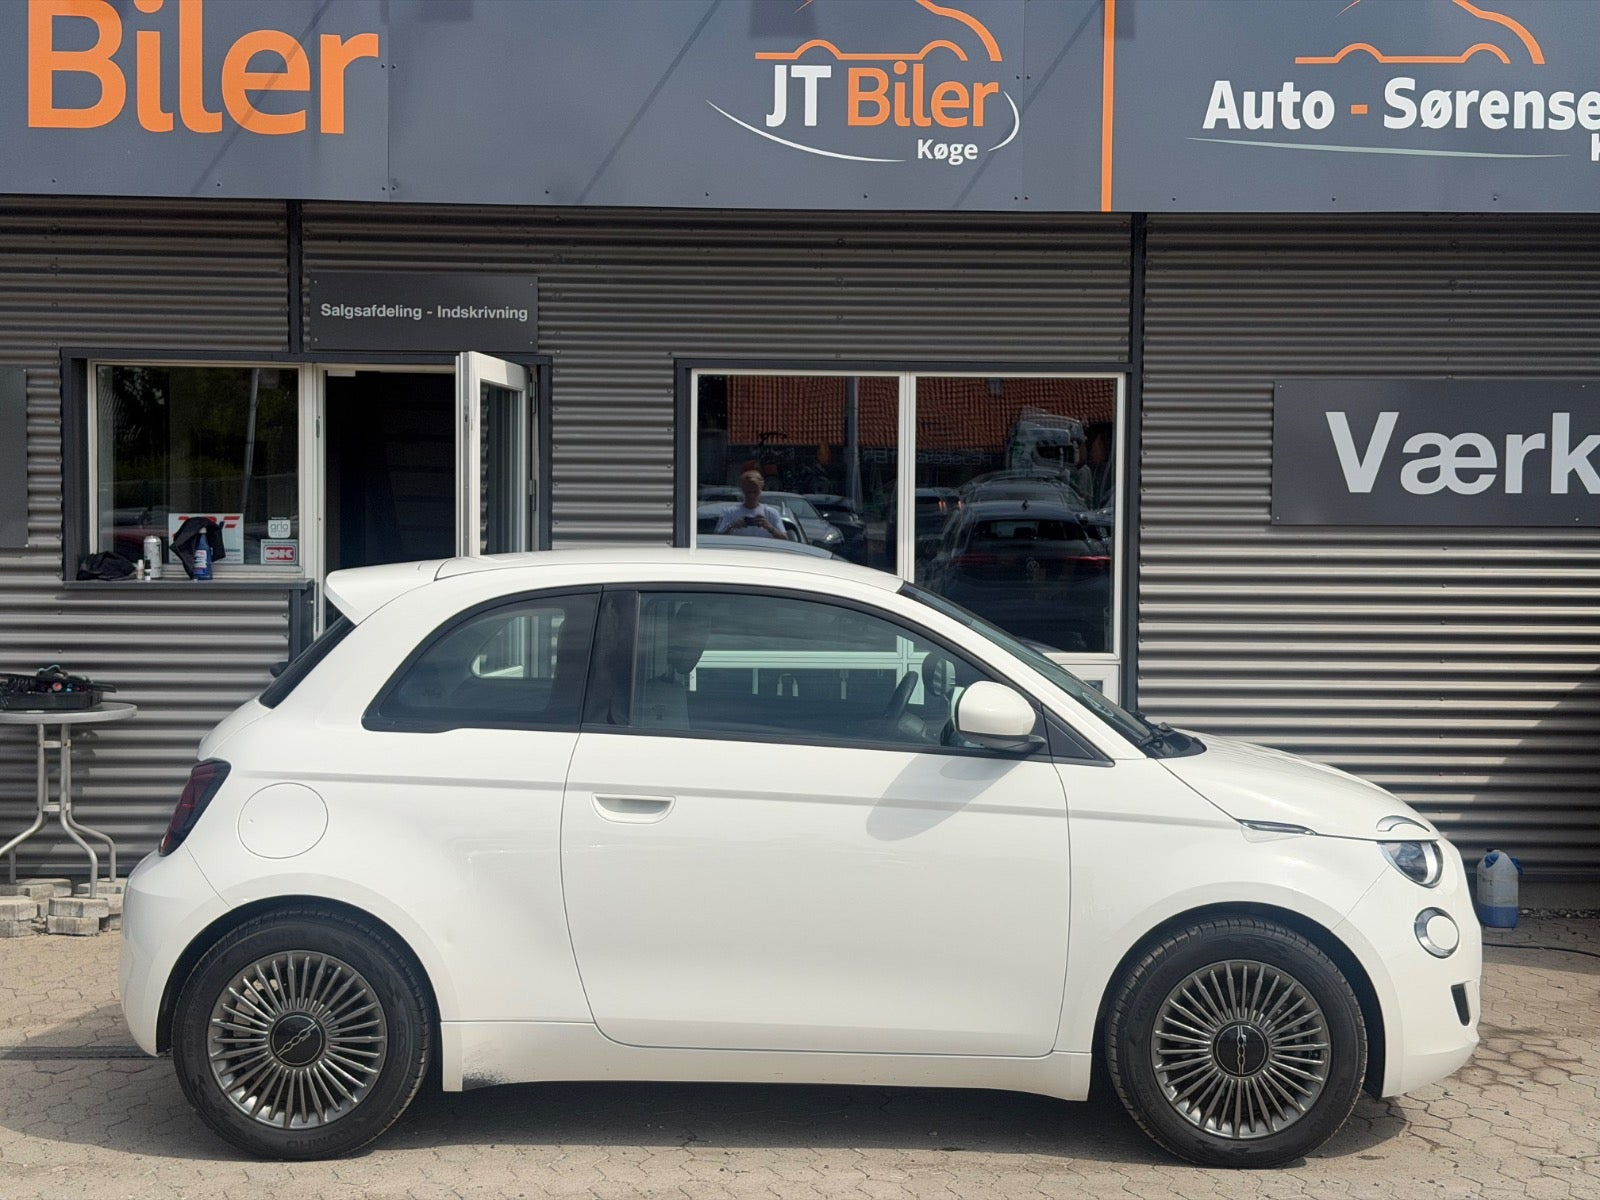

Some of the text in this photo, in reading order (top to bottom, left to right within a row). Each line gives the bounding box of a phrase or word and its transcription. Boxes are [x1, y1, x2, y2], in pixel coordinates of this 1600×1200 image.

[28, 0, 379, 135] Biler
[766, 60, 999, 128] JT Biler
[1203, 81, 1334, 129] Auto
[1384, 77, 1600, 130] Sørense
[918, 139, 978, 165] Køge
[320, 303, 422, 321] Salgsafdeling
[437, 305, 528, 322] Indskrivning
[1326, 412, 1600, 494] Værk
